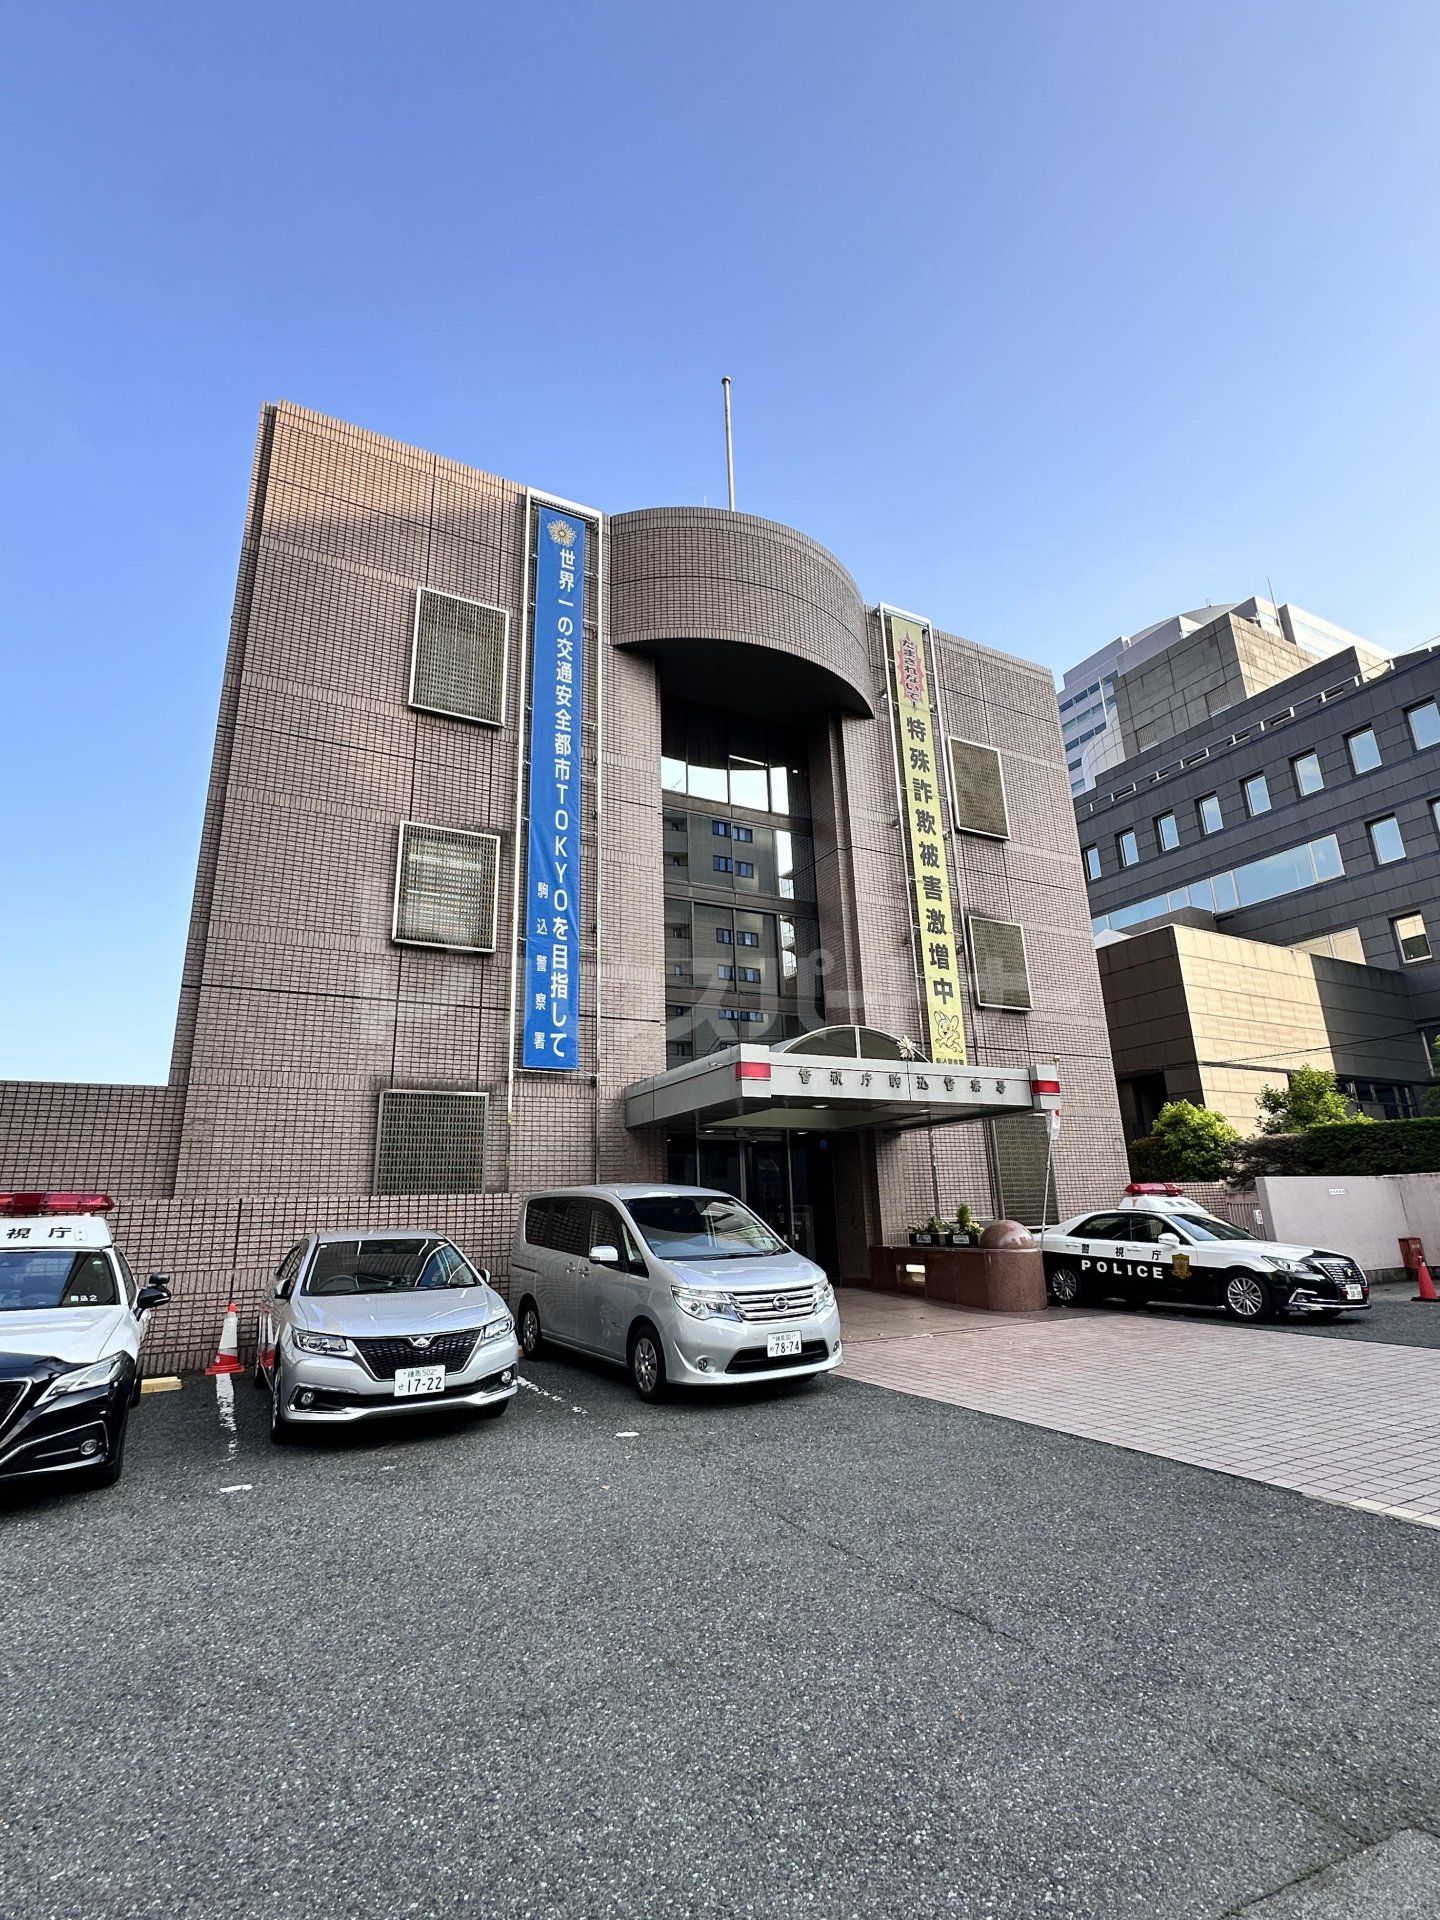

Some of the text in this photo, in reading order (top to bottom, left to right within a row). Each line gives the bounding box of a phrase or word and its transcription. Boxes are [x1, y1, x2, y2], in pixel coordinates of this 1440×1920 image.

[549, 549, 576, 1058] 世界一の交通安全都市TOKYOを目指して
[907, 716, 954, 1005] 特殊詐欺被害激増中
[534, 882, 549, 1050] 駒込警察署
[1081, 1259, 1164, 1279] POLICE
[408, 1377, 442, 1393] 17-22
[775, 1341, 800, 1354] 78-74
